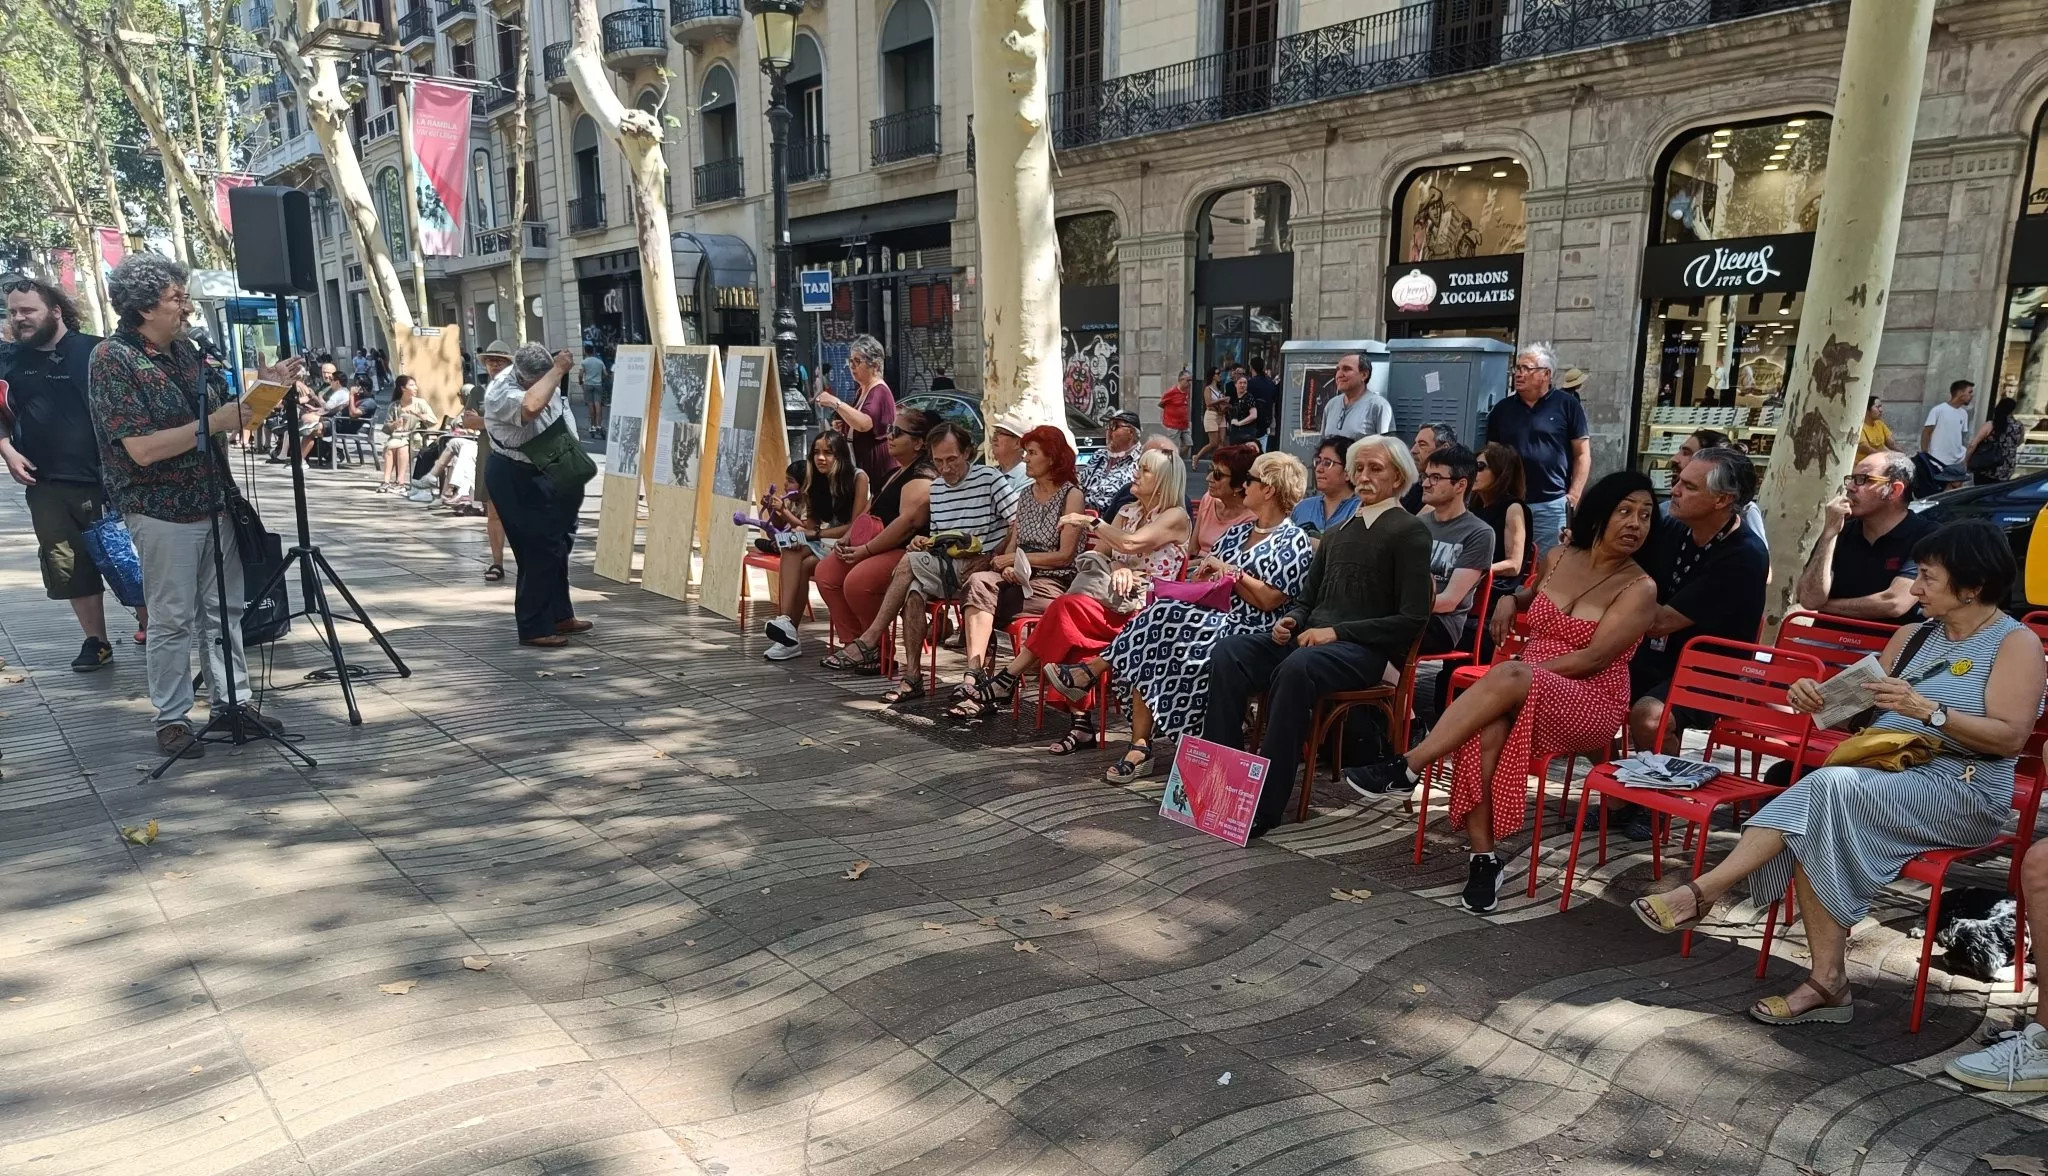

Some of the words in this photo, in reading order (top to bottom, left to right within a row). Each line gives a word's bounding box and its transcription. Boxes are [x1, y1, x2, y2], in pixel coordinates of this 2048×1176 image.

[1683, 245, 1781, 288] Vicens
[1448, 270, 1509, 287] TORRONS
[1715, 275, 1742, 287] 1775
[803, 282, 829, 294] TAXI
[1439, 288, 1515, 305] XOCOLATES
[1192, 749, 1210, 759] RAMBLA
[1225, 785, 1238, 794] Albert
[1237, 789, 1255, 799] Einstein
